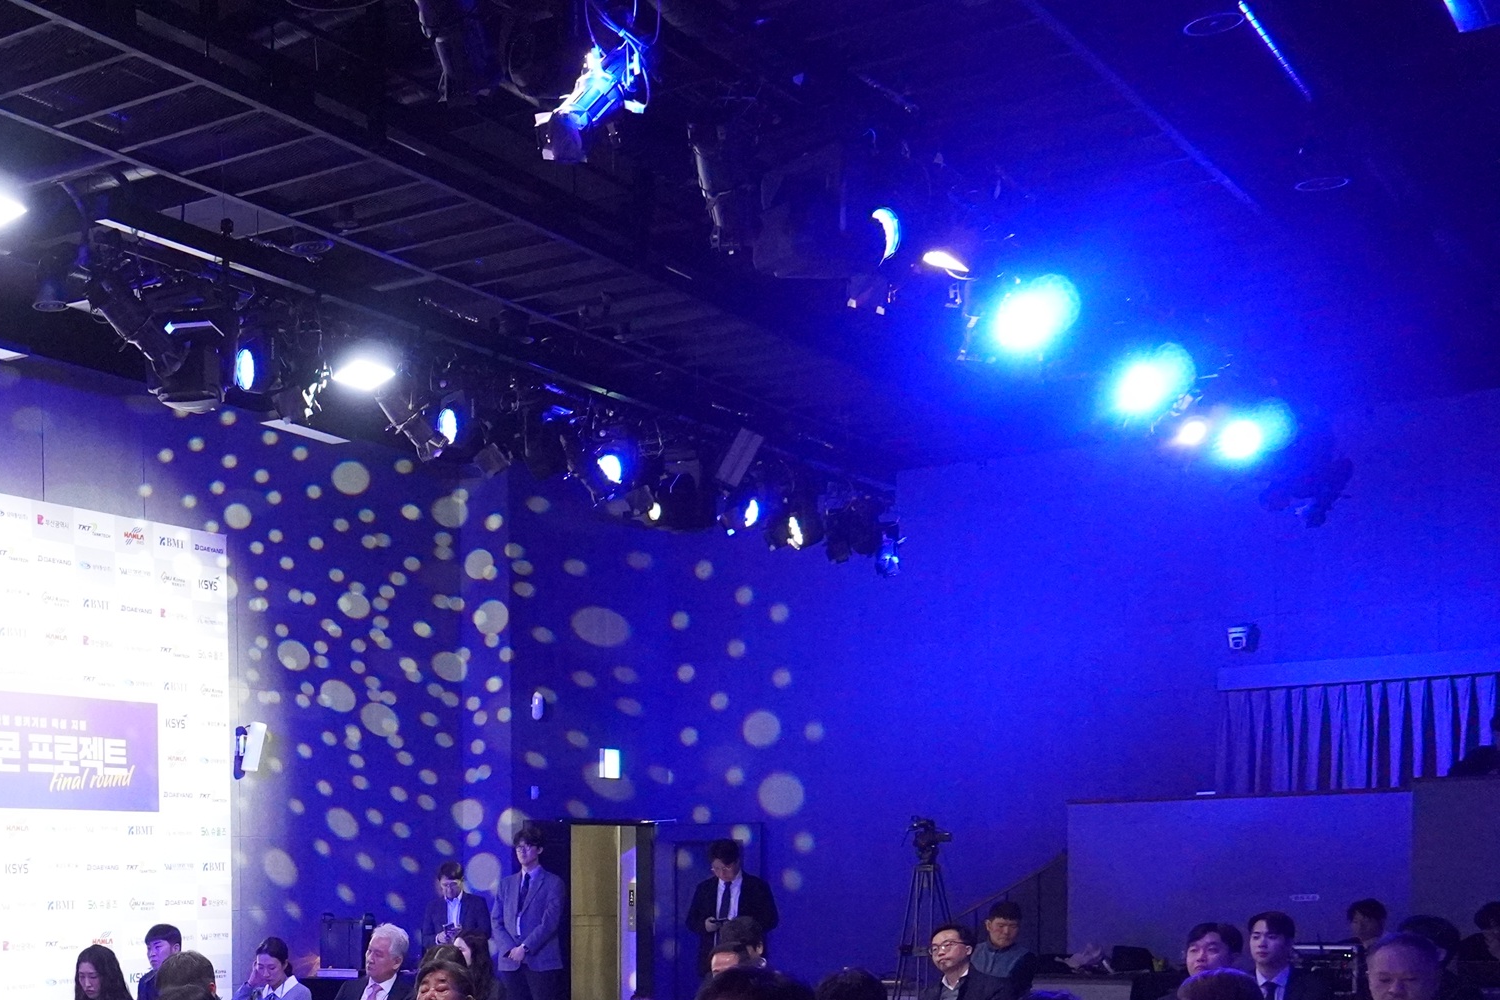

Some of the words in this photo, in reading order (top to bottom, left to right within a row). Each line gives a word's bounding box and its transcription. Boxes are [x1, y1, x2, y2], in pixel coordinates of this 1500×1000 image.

[78, 523, 91, 531] TKT
[198, 579, 218, 592] KSYS
[166, 718, 186, 729] KSYS
[28, 733, 128, 775] 프로젝트
[5, 863, 28, 874] KSYS
[209, 862, 226, 871] BMT
